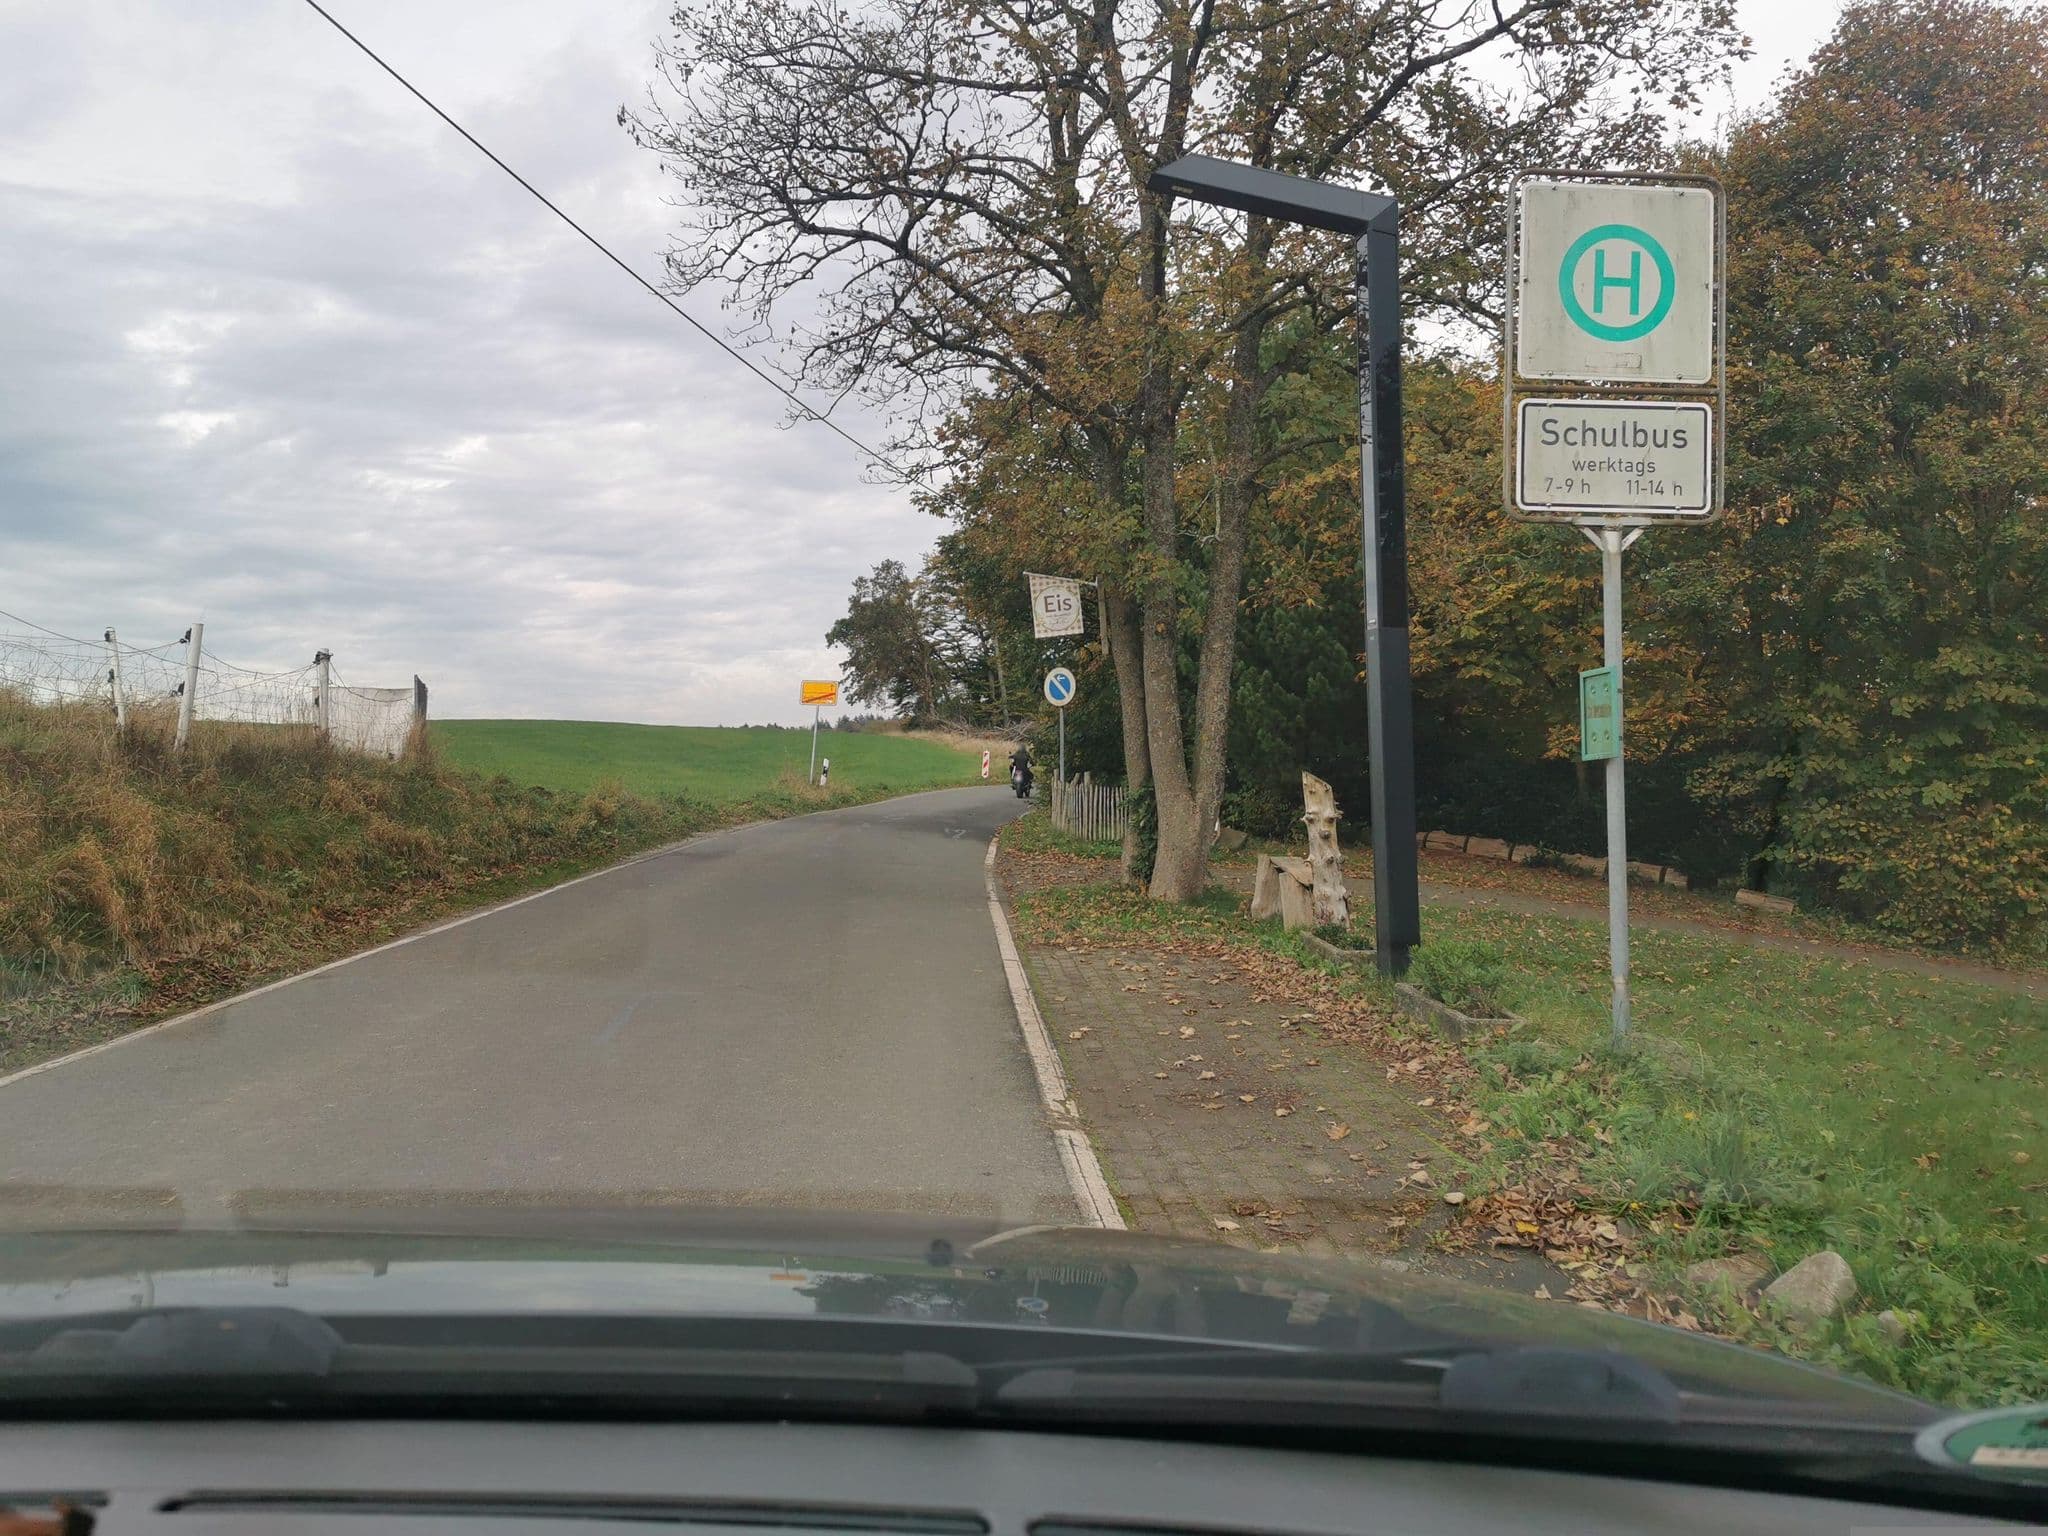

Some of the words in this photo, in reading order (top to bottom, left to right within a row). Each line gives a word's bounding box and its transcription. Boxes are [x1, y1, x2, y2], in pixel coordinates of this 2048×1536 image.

[1594, 249, 1641, 315] H
[1541, 419, 1688, 449] Schulbus
[1572, 457, 1656, 477] werktags
[1545, 478, 1574, 493] 7-9
[1581, 478, 1591, 494] h
[1626, 480, 1665, 496] 11-14
[1673, 481, 1683, 496] h
[1044, 594, 1072, 613] Eis
